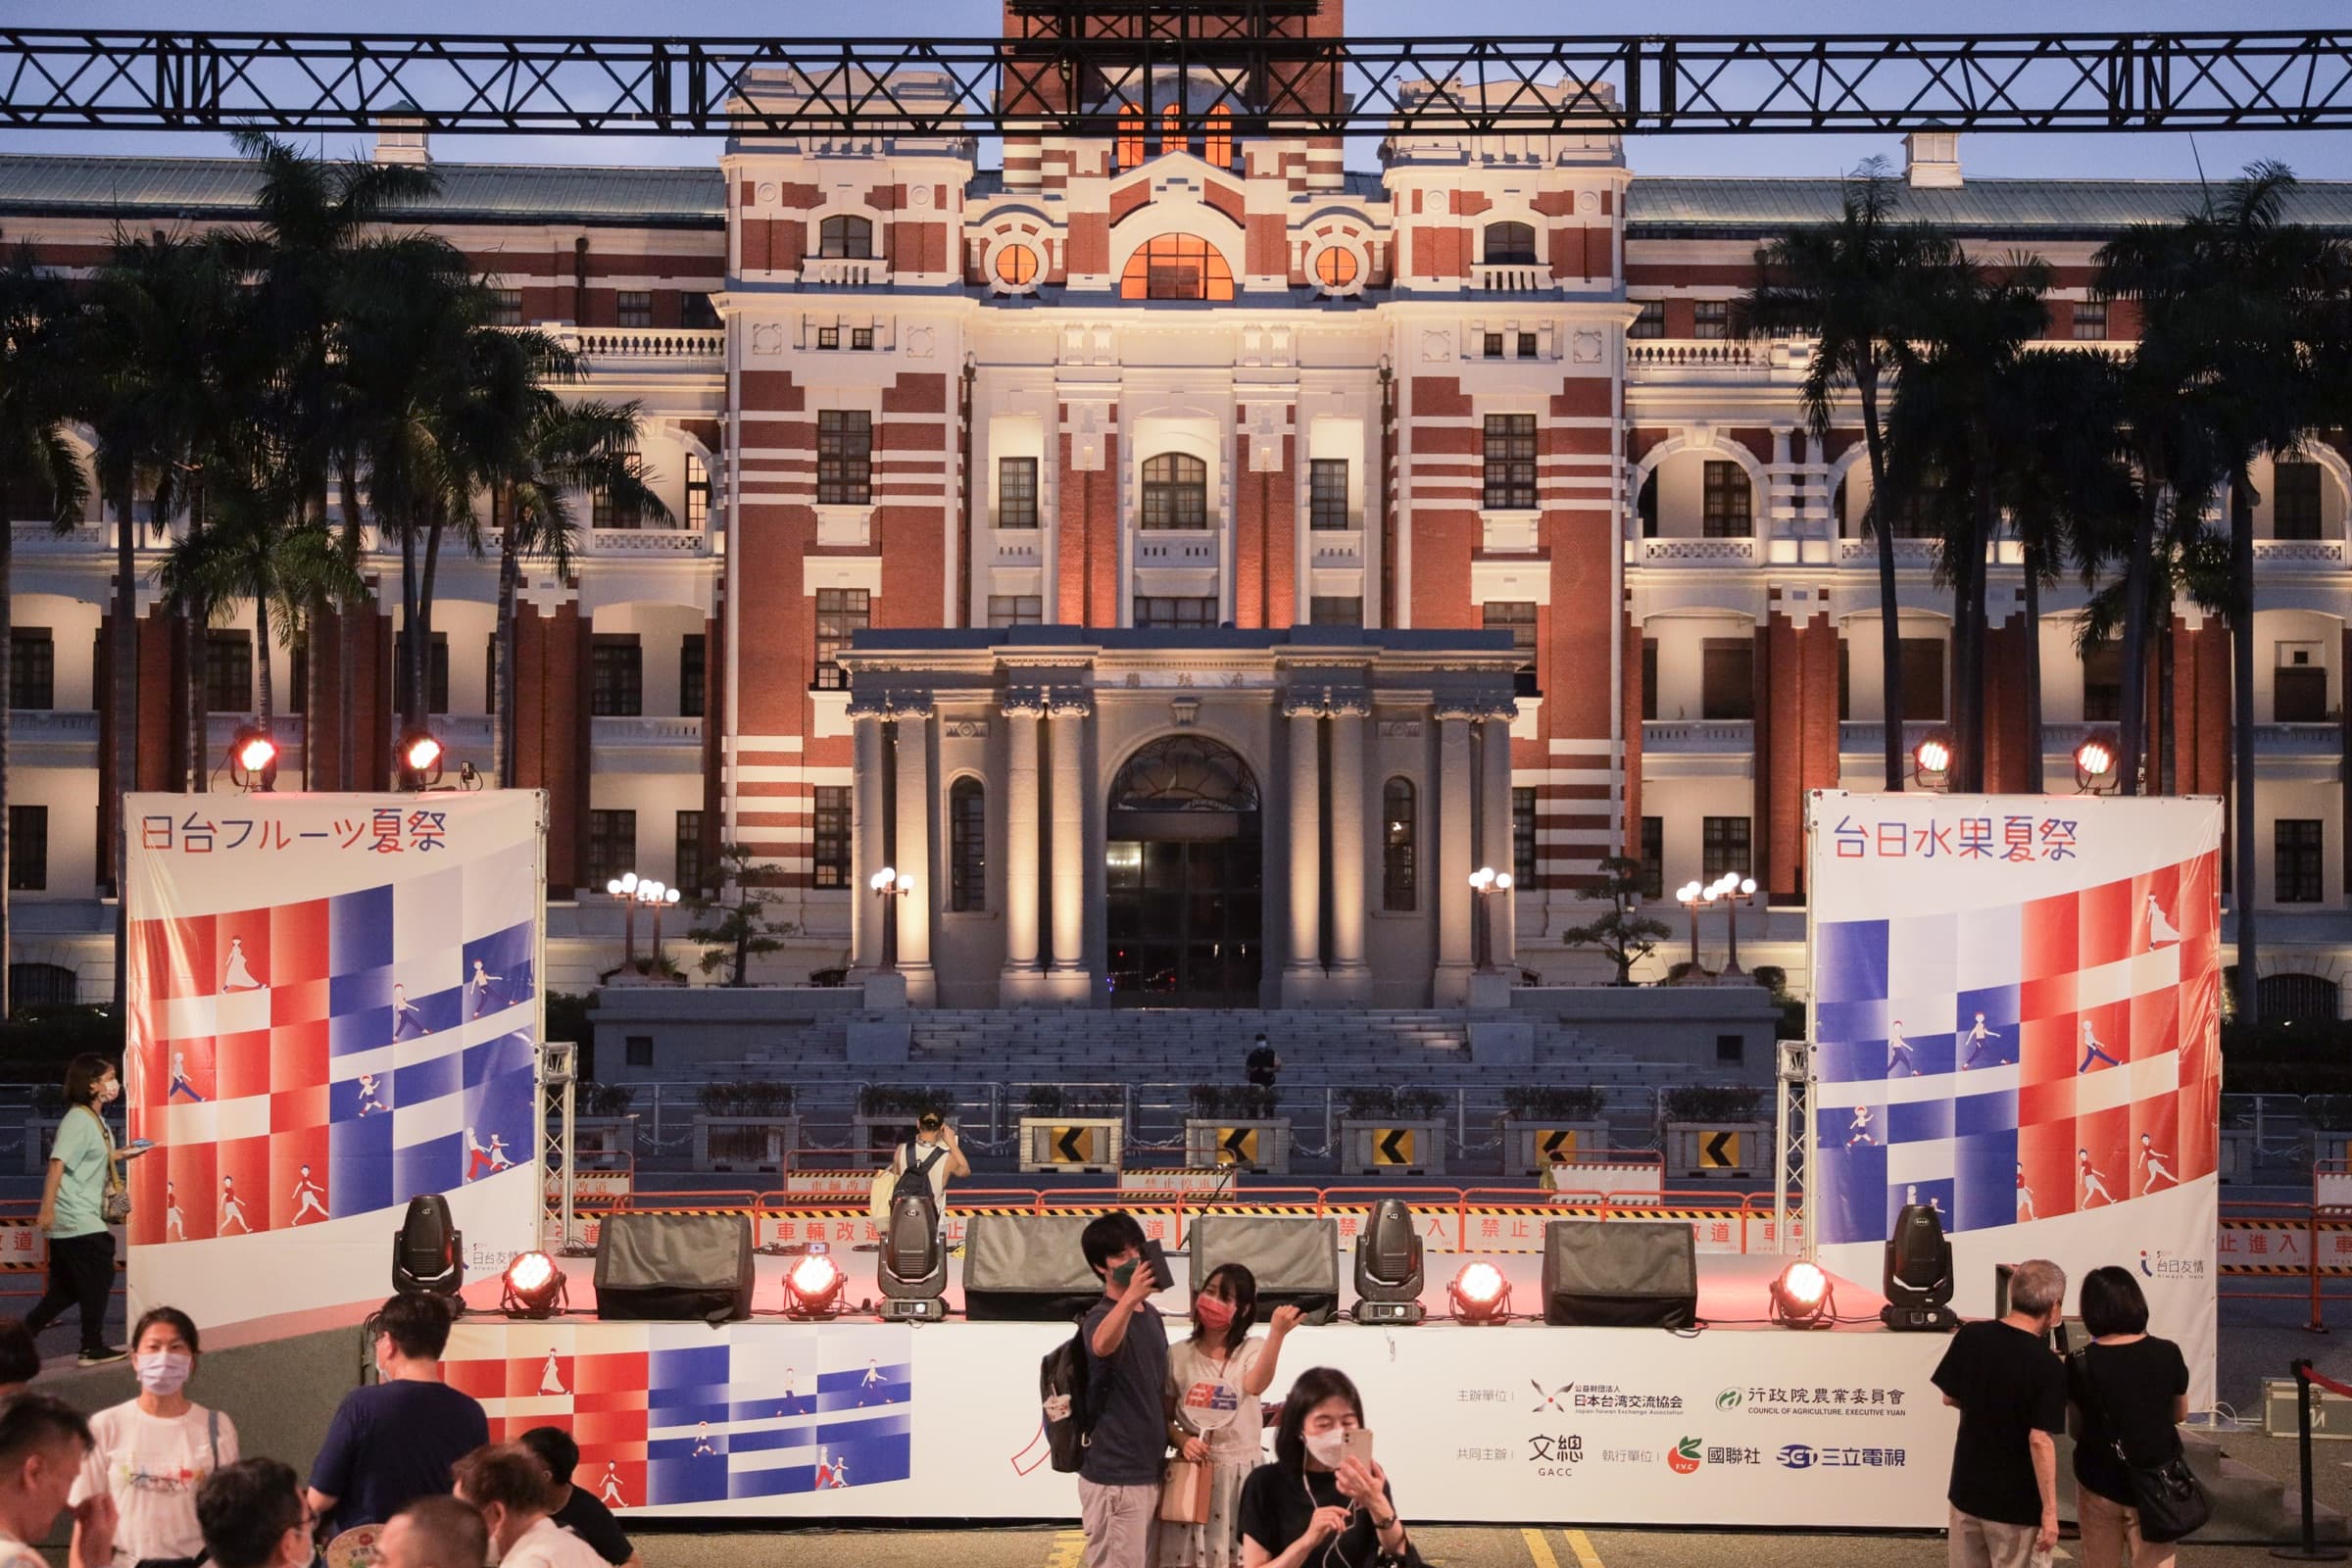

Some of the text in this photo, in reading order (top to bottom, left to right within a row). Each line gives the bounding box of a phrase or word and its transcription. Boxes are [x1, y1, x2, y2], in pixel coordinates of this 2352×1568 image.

[142, 808, 447, 854] 日台フルーツ夏祭
[1834, 814, 2079, 861] 台日水果夏祭
[2157, 1259, 2204, 1273] 台日友情
[1574, 1395, 1684, 1409] 日本台湾交流協会
[1748, 1388, 1905, 1405] 行政院農業委員會
[1529, 1434, 1584, 1462] 文總
[1707, 1446, 1761, 1464] 國聯社
[1821, 1446, 1906, 1466] 三立電視
[1538, 1467, 1573, 1477] GACC
